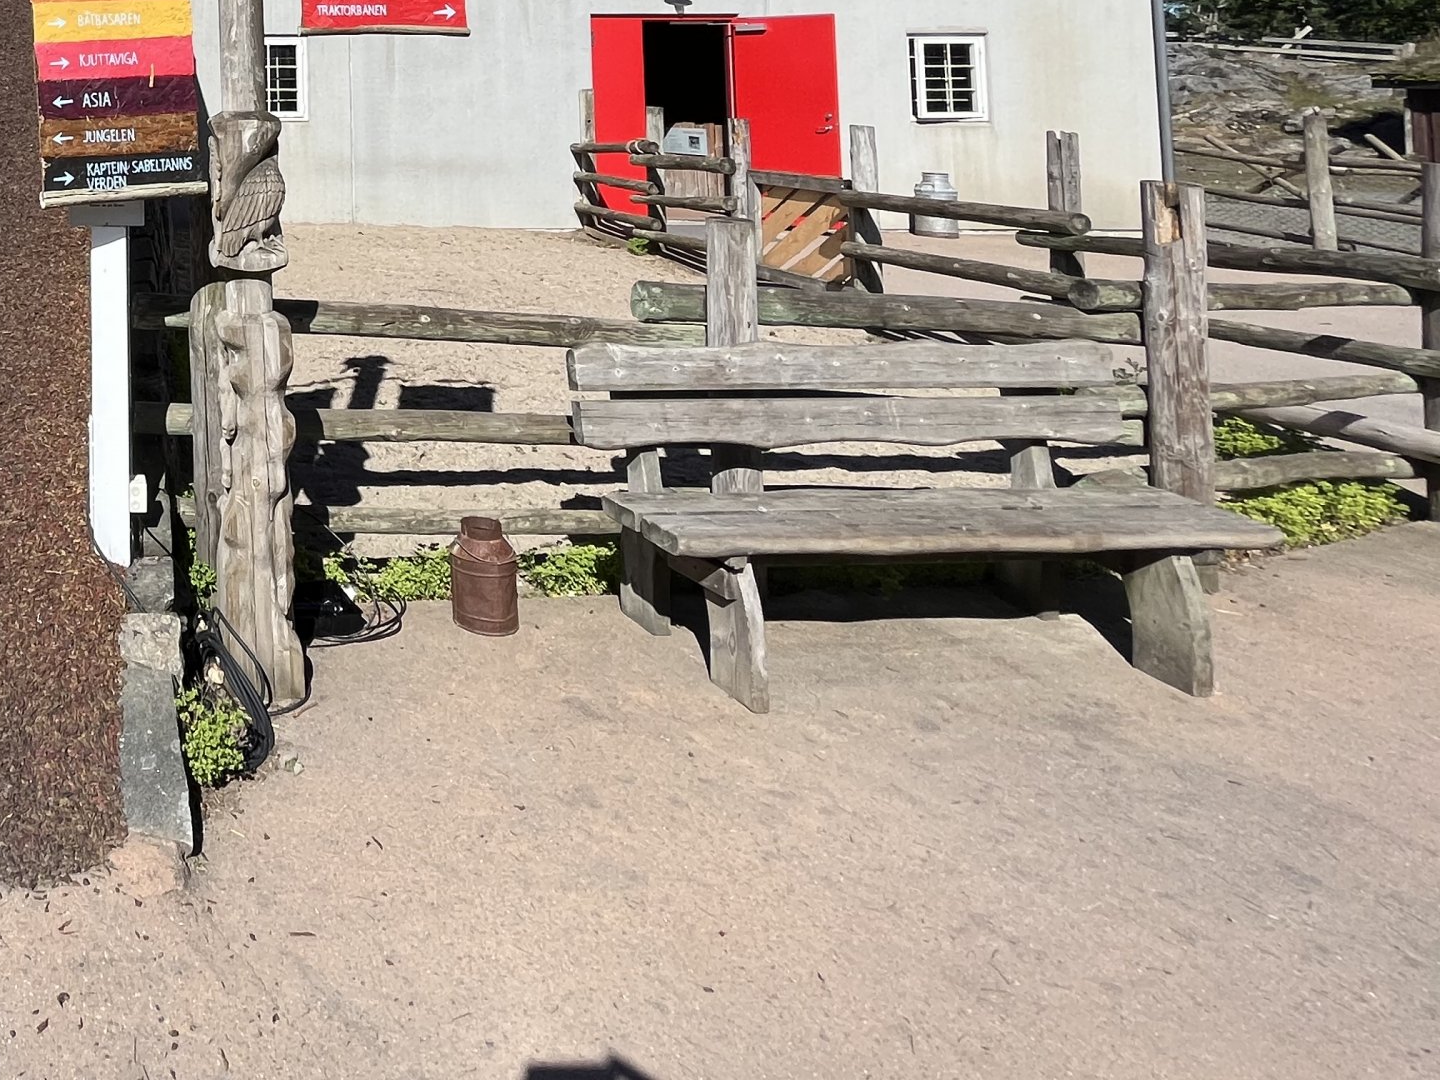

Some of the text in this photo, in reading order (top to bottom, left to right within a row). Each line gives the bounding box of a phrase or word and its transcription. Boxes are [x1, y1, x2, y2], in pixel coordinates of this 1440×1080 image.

[316, 4, 388, 17] TRAKTORBANEN
[77, 10, 141, 28] BÅTBASAREN
[79, 51, 138, 67] KJUTTAVIGA
[82, 92, 112, 108] ASIA
[82, 128, 136, 143] JUNGELEN
[86, 157, 193, 176] KAPTEIN SABELTANNS
[86, 176, 127, 191] VERDEN
